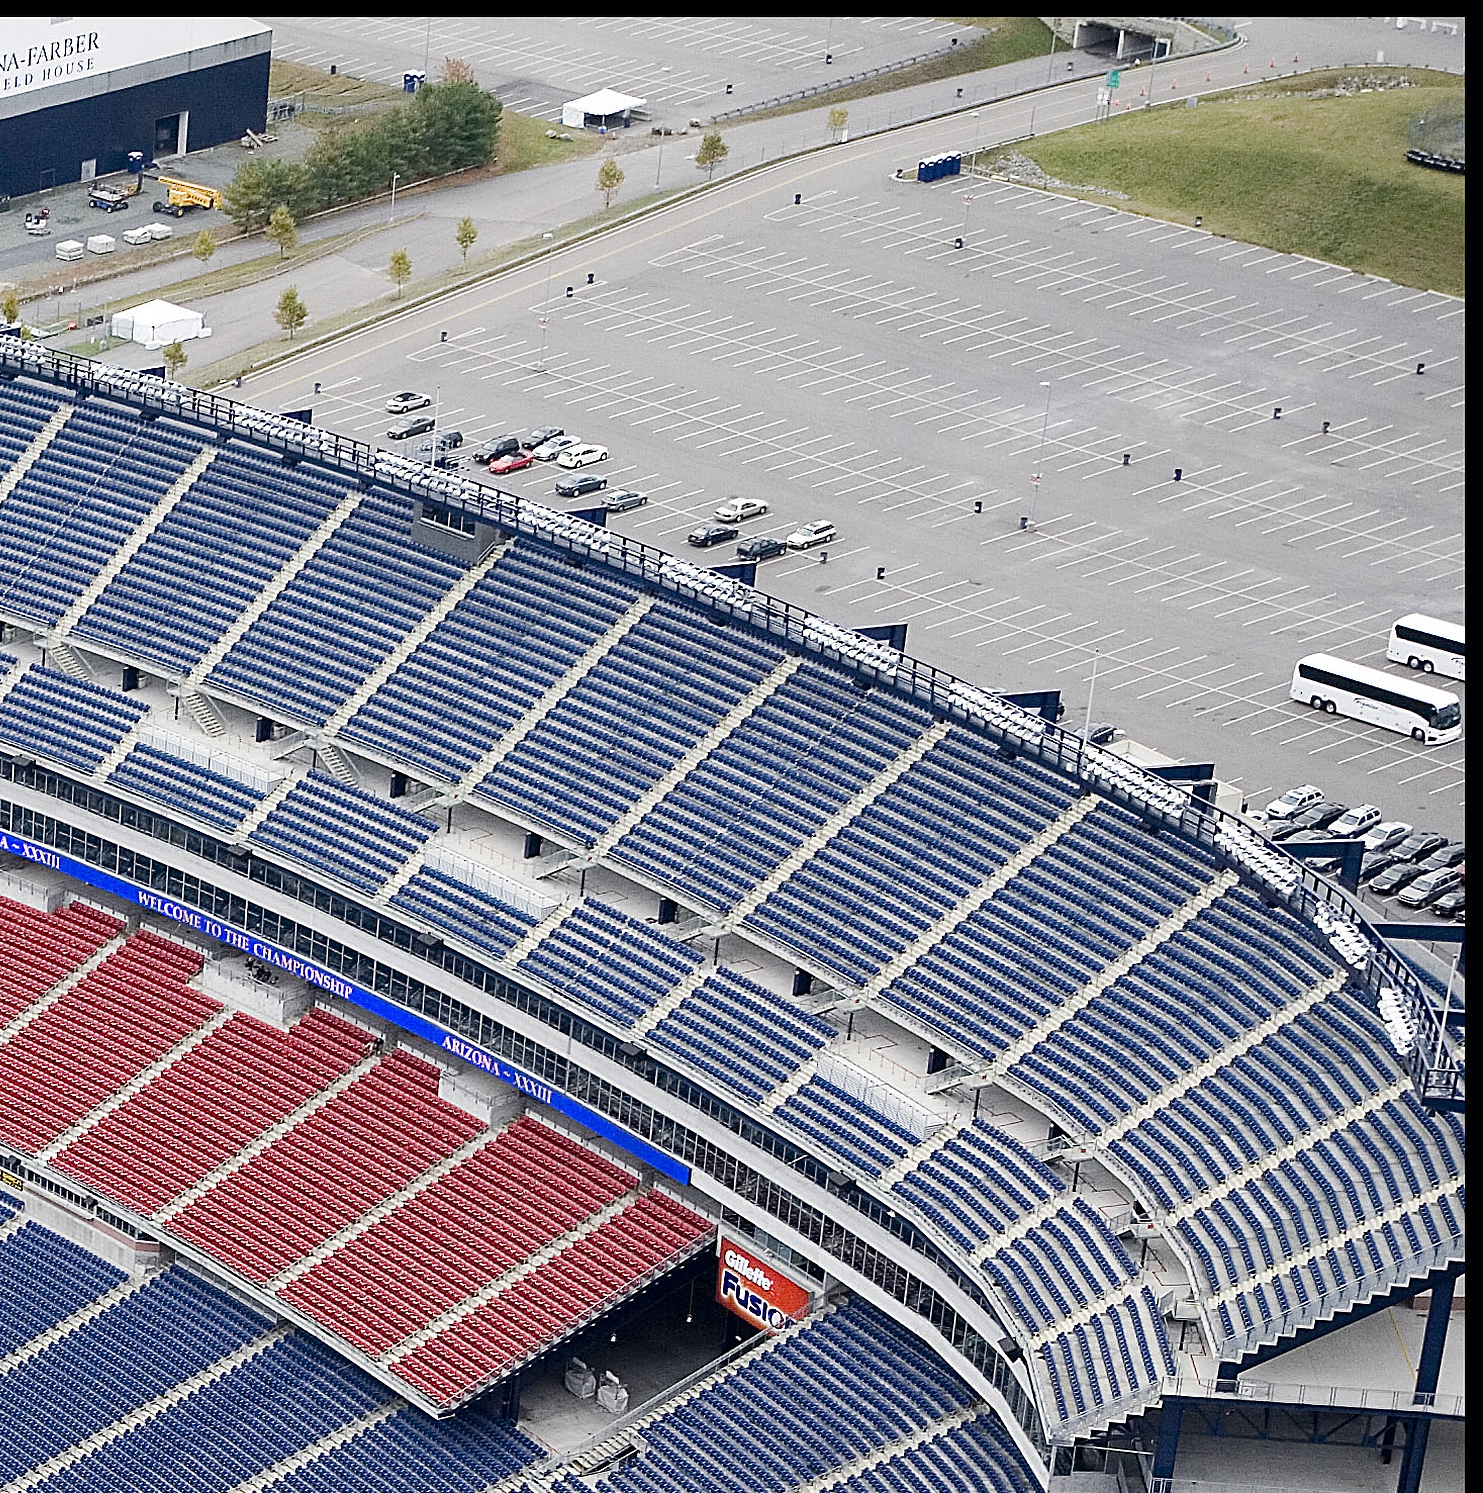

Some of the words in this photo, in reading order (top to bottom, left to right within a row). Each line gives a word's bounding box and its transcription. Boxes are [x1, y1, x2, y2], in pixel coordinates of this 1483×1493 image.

[43, 58, 95, 81] HOUSE
[22, 845, 61, 870] XXXIII
[137, 891, 201, 929] WELCOME
[205, 919, 223, 938] TO
[223, 927, 250, 951] THE
[253, 942, 353, 1000] CHAMPIONSHIP
[442, 1035, 500, 1075] ARIZONA
[513, 1073, 552, 1104] XXXIII
[725, 1250, 771, 1291] Gillette
